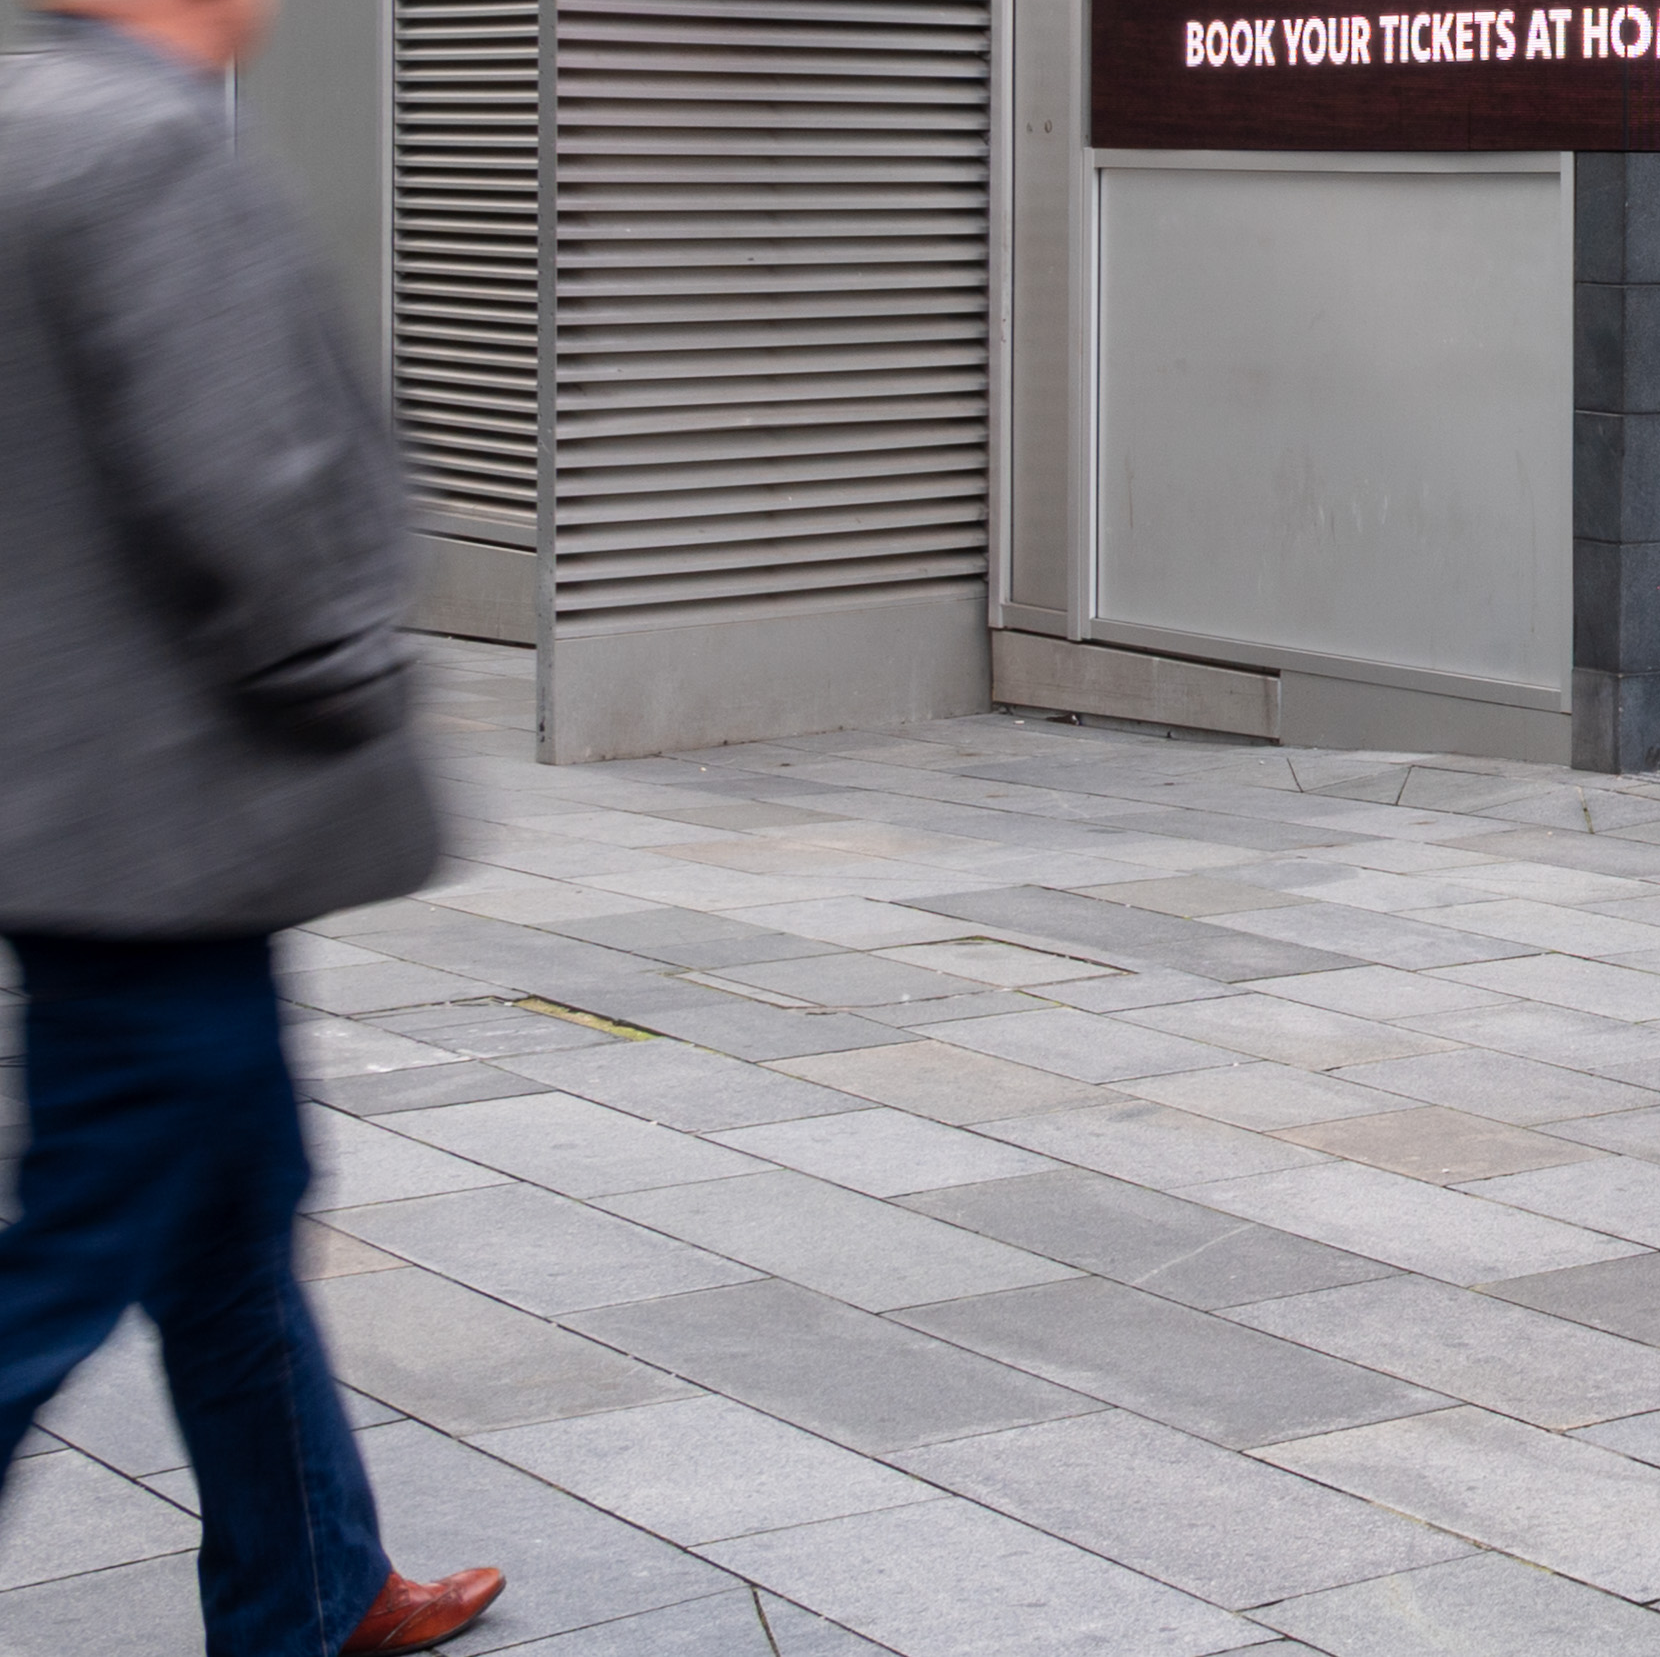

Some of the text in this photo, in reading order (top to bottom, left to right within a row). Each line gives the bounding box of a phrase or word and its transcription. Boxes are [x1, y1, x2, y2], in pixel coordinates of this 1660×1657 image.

[1186, 18, 1276, 68] BOOK
[1282, 15, 1371, 66] YOUR
[1378, 8, 1516, 64] TICKETS
[1525, 8, 1572, 60] AT
